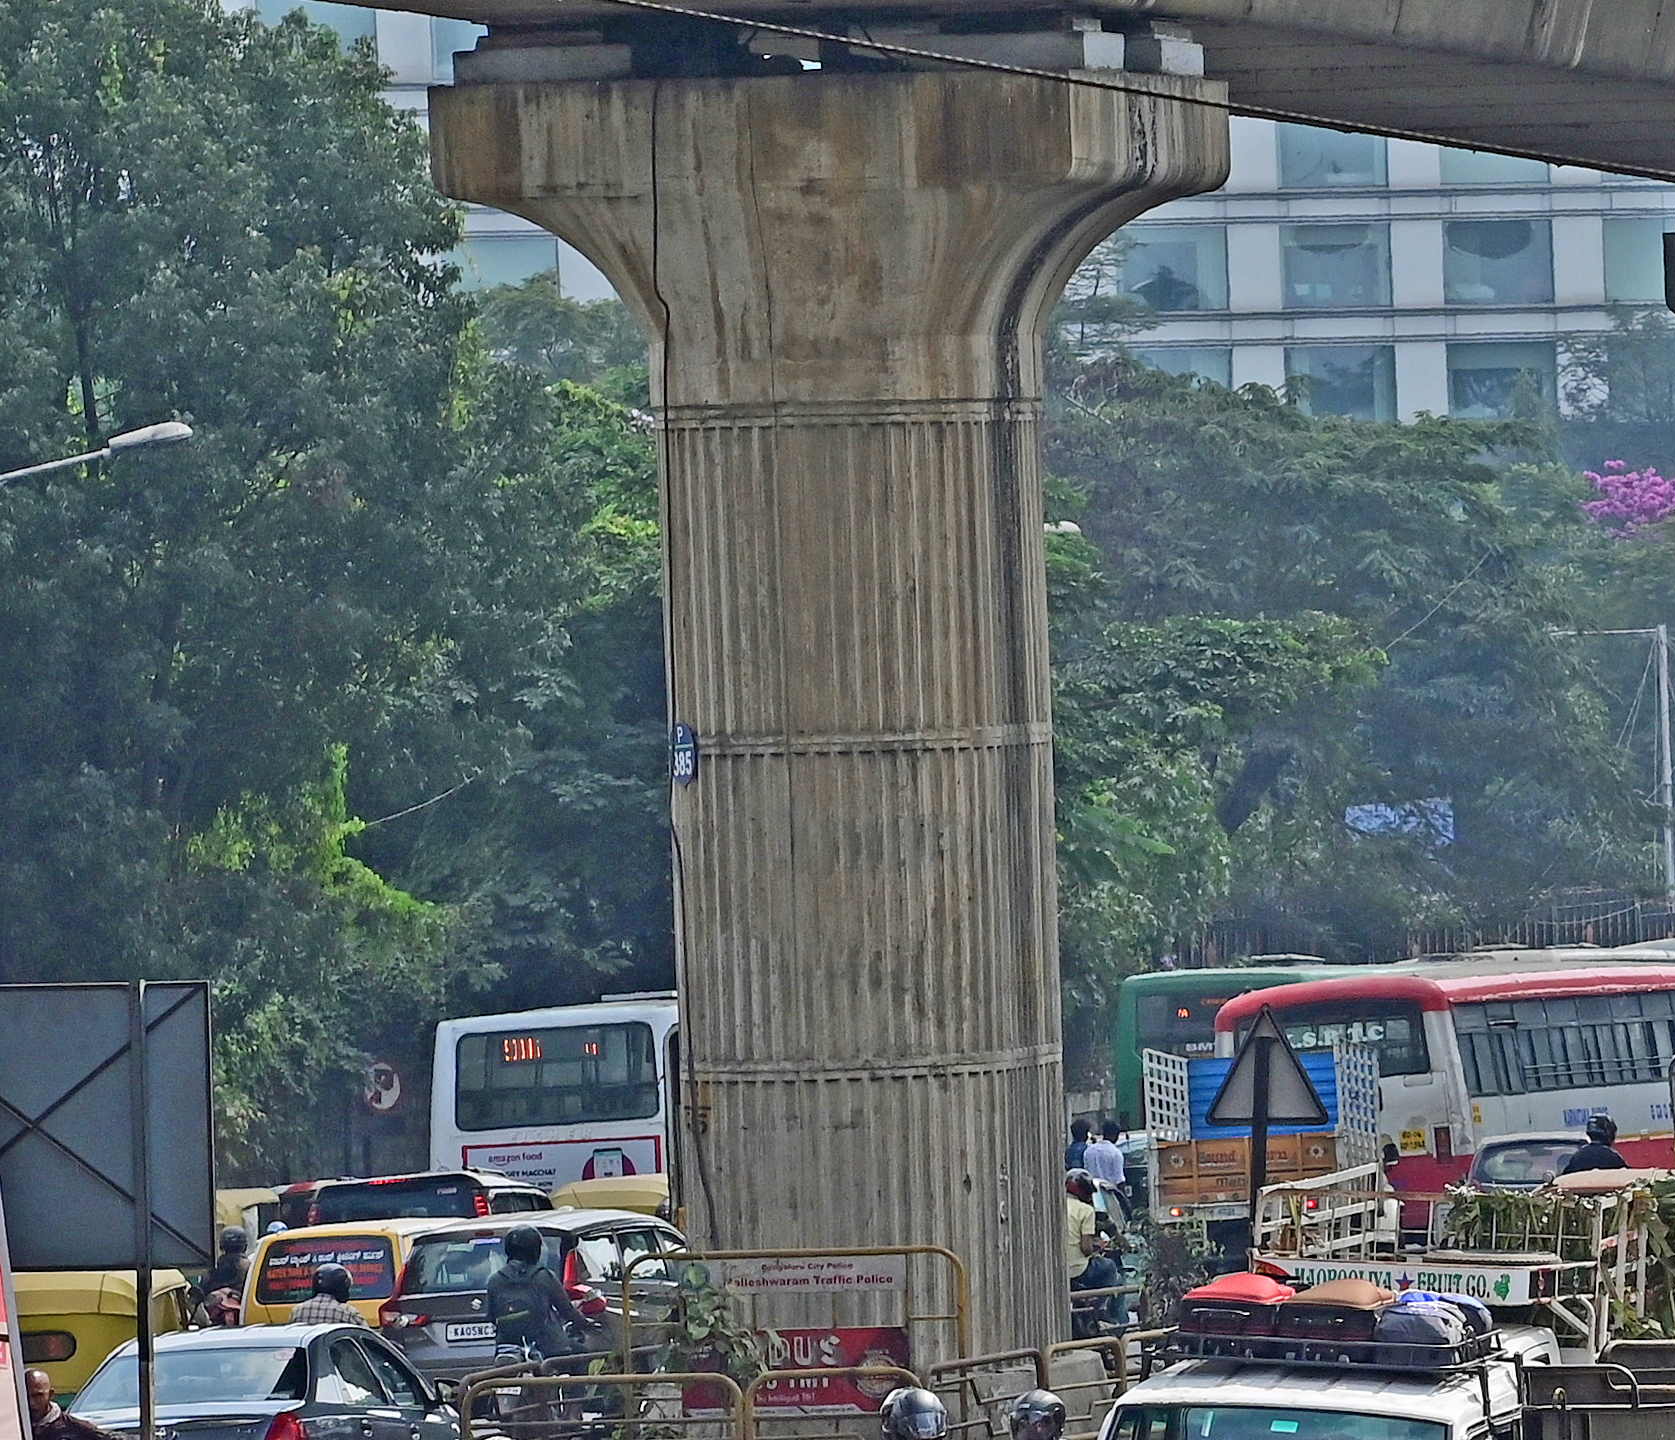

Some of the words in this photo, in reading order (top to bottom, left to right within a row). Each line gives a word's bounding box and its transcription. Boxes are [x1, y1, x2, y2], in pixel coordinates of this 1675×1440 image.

[488, 1154, 521, 1166] amazon
[522, 1151, 543, 1161] food
[807, 1261, 825, 1271] City
[827, 1261, 854, 1270] Police
[813, 1274, 853, 1286] Traffic
[856, 1274, 893, 1285] Police
[1417, 1271, 1462, 1293] FRUIT
